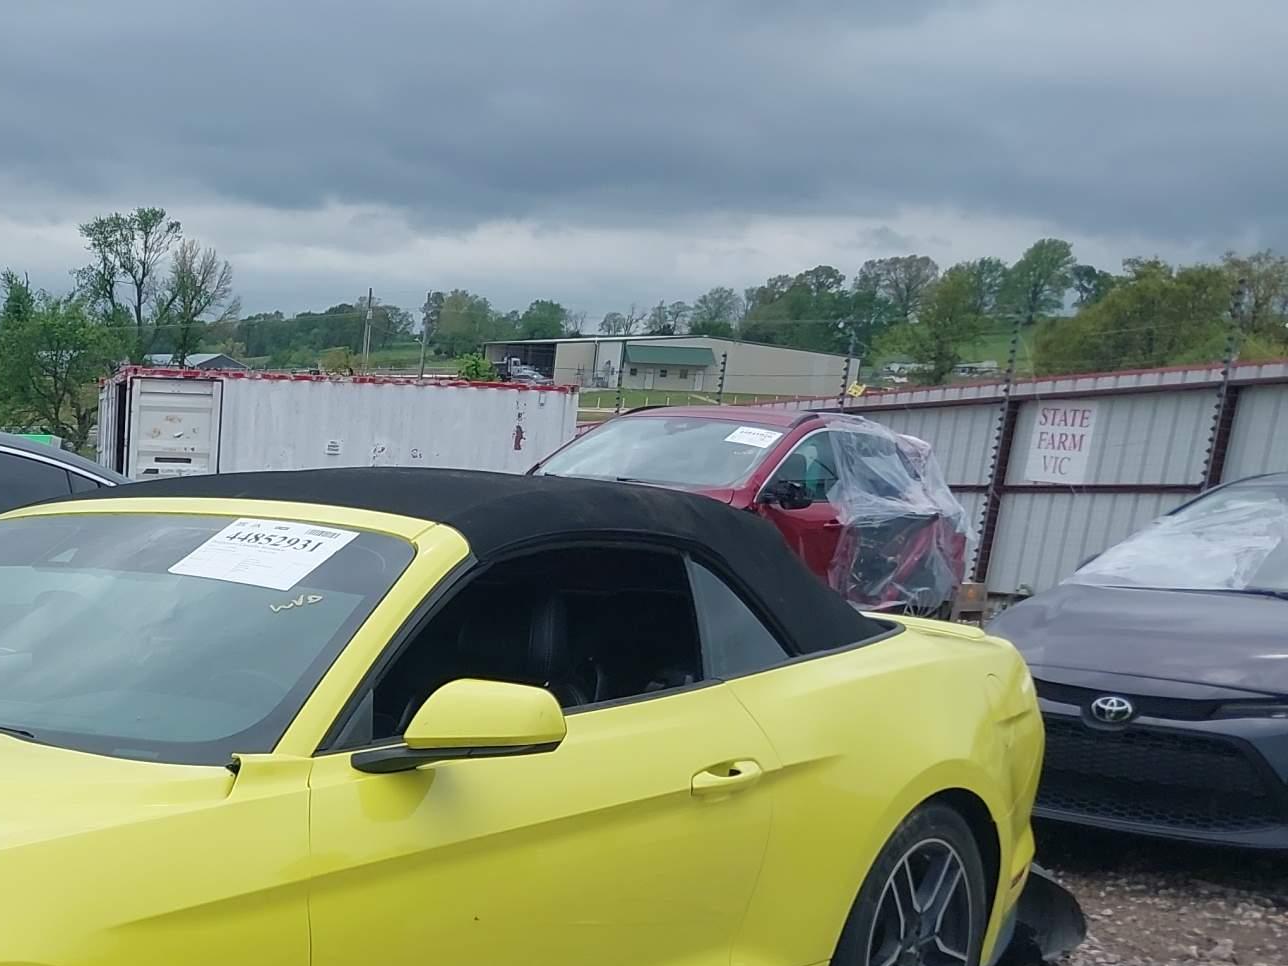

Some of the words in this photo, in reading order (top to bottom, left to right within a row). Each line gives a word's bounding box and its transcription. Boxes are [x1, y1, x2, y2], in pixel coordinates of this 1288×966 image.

[1039, 407, 1092, 428] STATE
[1037, 431, 1086, 452] FARM
[1042, 455, 1071, 475] VIC
[226, 530, 324, 553] 44852931
